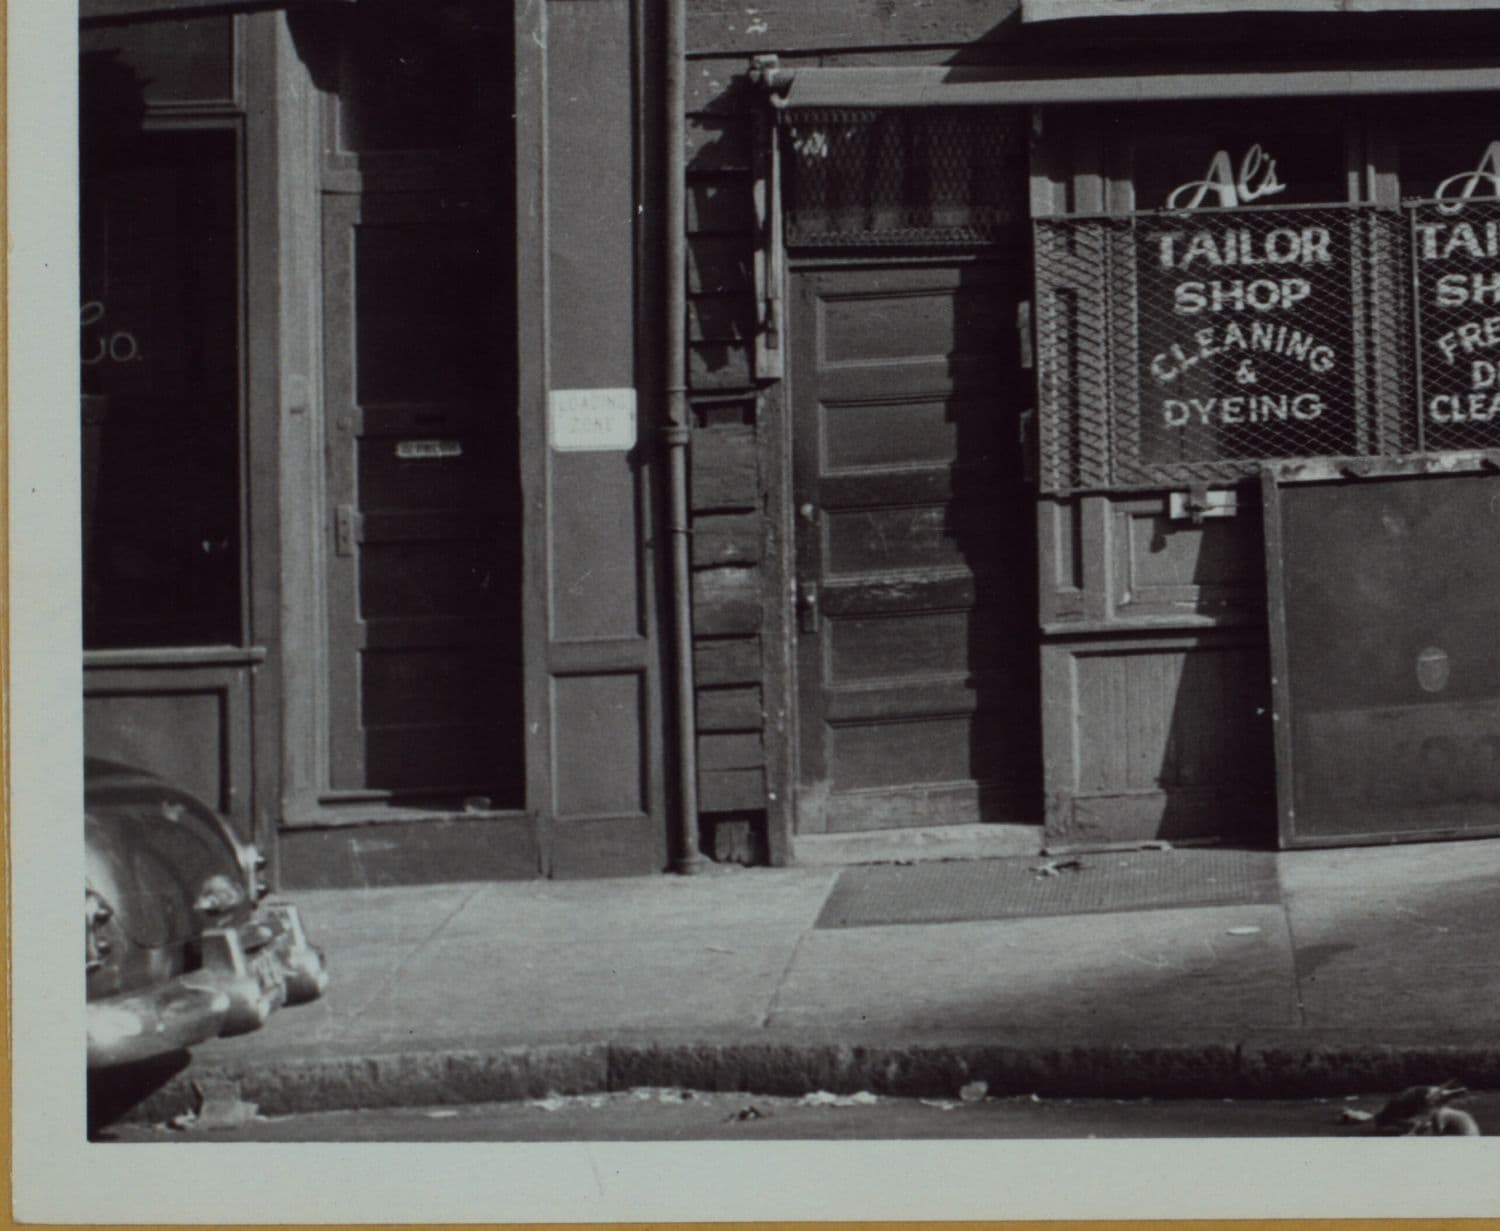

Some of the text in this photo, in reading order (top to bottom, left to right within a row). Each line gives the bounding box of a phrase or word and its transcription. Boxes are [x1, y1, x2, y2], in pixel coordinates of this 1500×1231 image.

[1166, 144, 1286, 218] Al's
[1147, 227, 1333, 269] TAILOR
[1174, 278, 1311, 315] SHOP
[1151, 320, 1335, 382] CLEANING
[1235, 359, 1257, 385] &
[1163, 393, 1327, 427] DYEING
